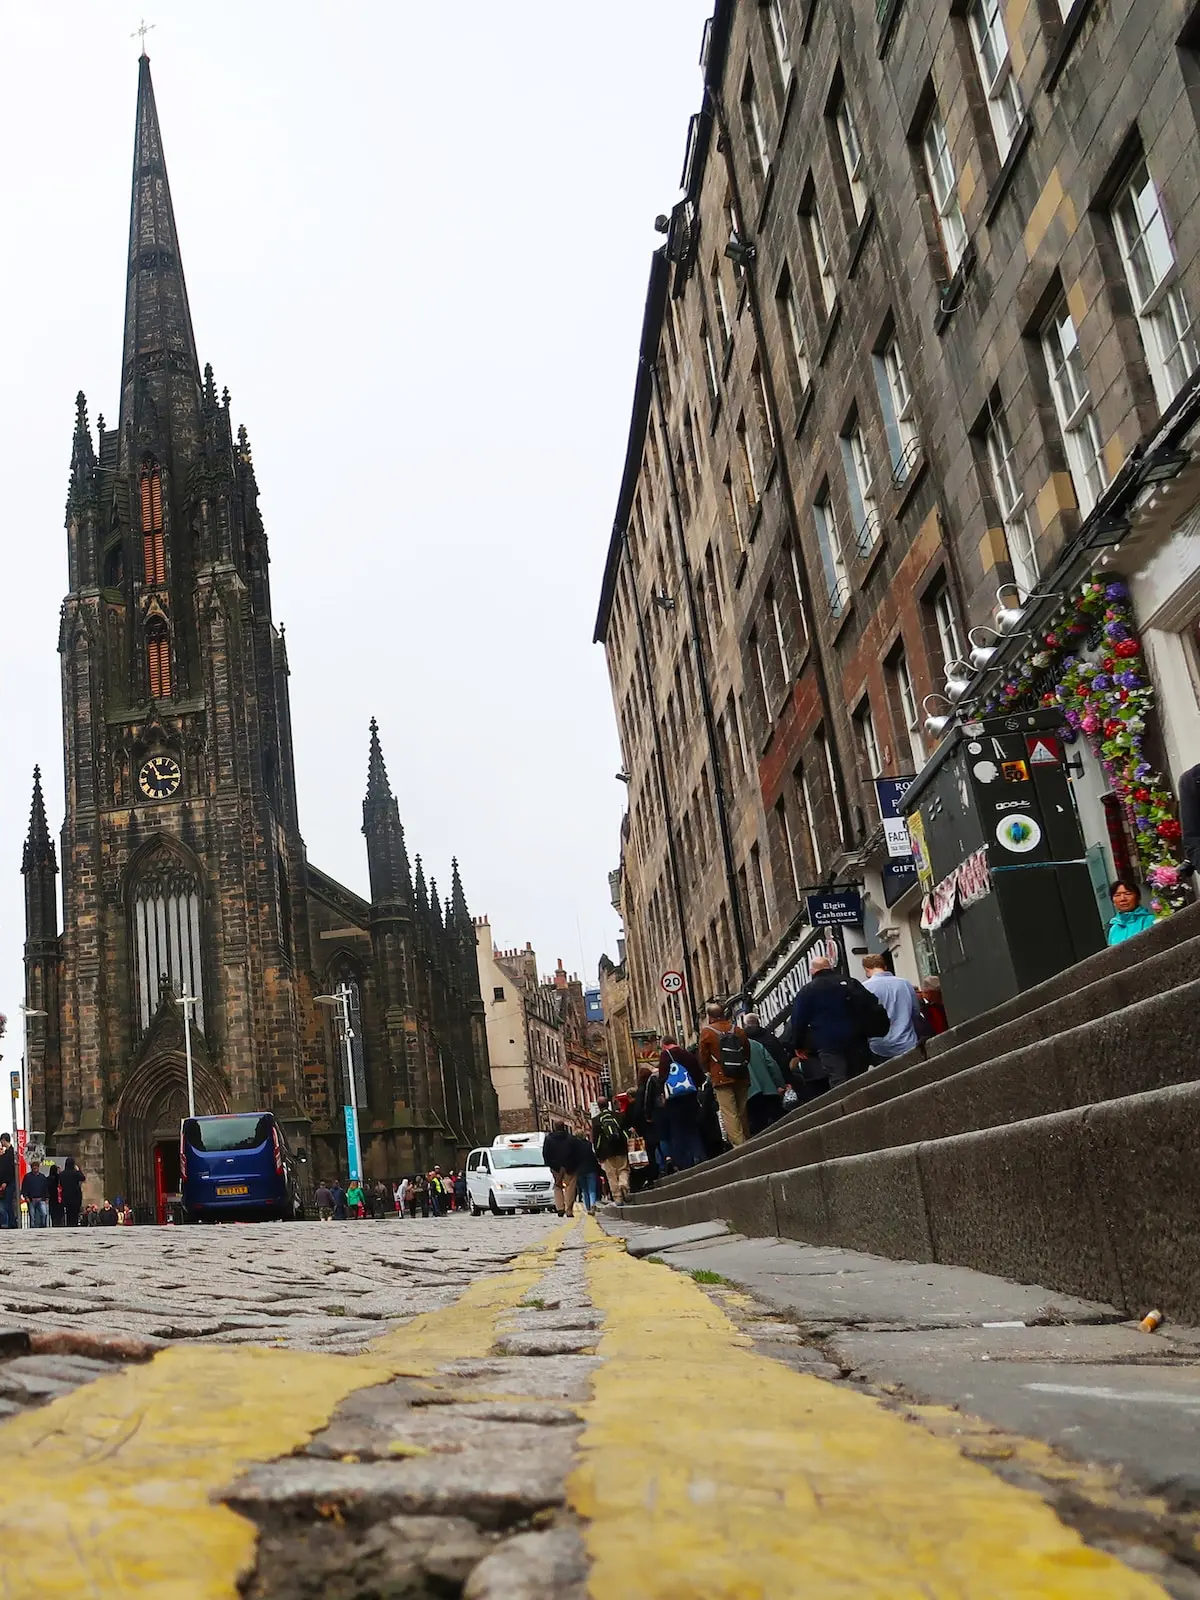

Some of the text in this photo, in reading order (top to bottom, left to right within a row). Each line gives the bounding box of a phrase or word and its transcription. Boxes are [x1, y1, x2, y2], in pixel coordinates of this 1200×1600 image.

[822, 902, 846, 910] Elgin
[815, 911, 857, 919] Cashmere
[664, 977, 680, 988] 20
